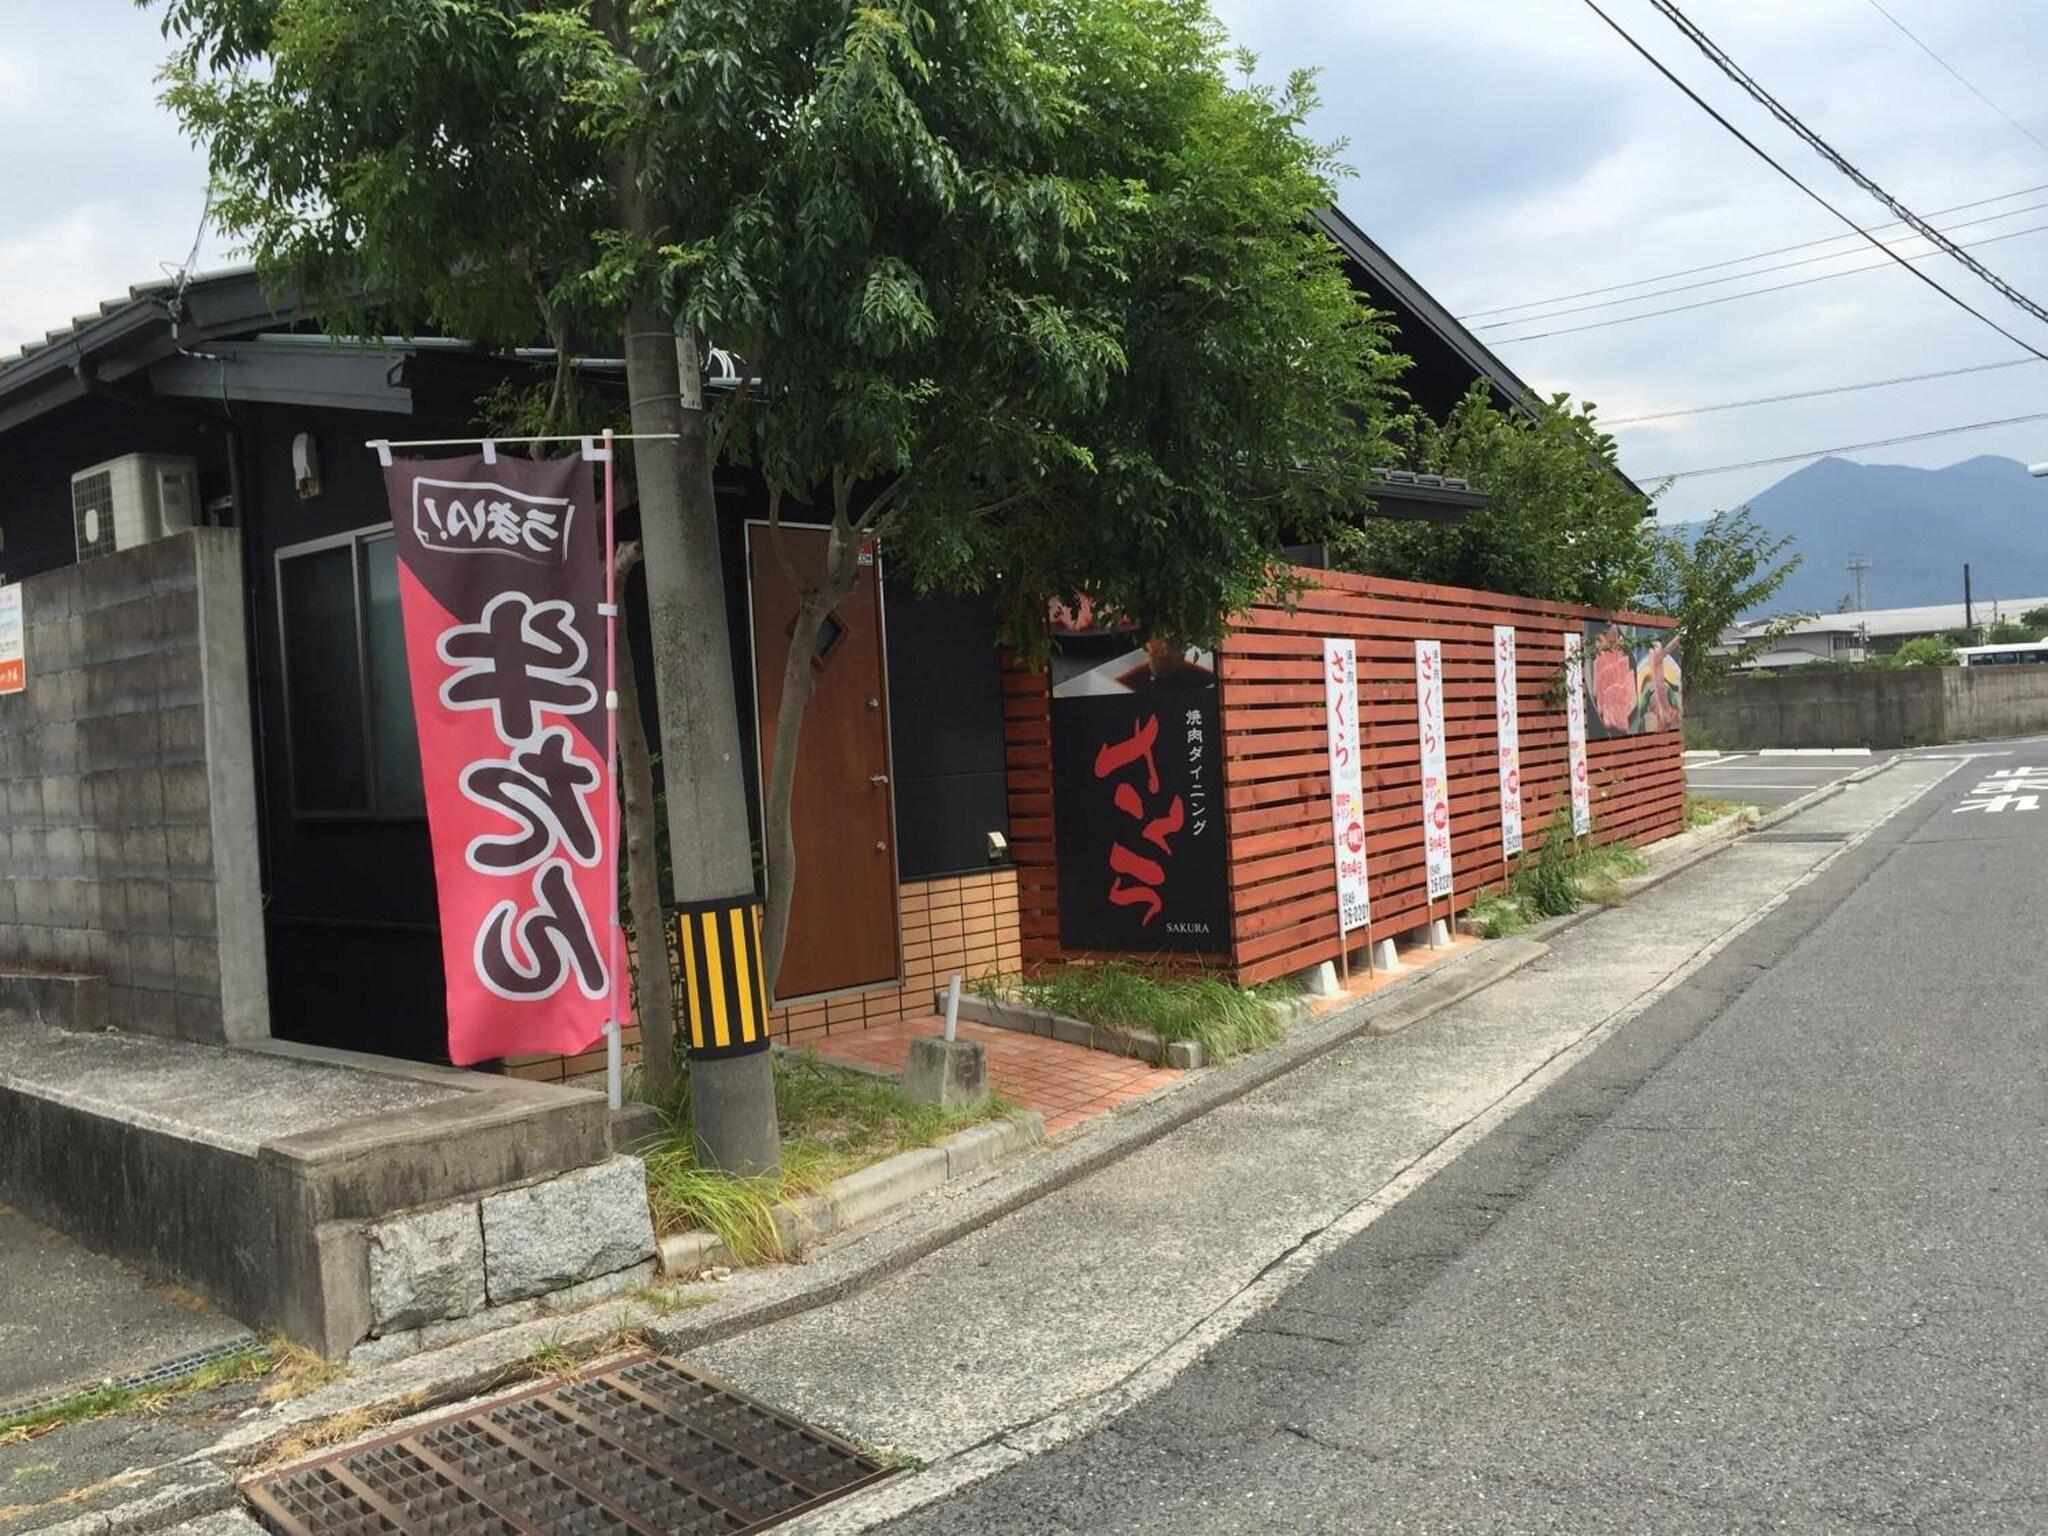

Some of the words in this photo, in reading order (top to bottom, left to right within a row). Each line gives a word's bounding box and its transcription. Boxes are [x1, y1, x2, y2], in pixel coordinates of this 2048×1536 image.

[1331, 650, 1349, 768] さくら
[1421, 650, 1437, 754] さくら
[1499, 634, 1511, 727] さくら
[1093, 712, 1186, 928] さくら
[1185, 708, 1208, 838] 焼肉ダイニング
[1165, 921, 1211, 934] SAKURA
